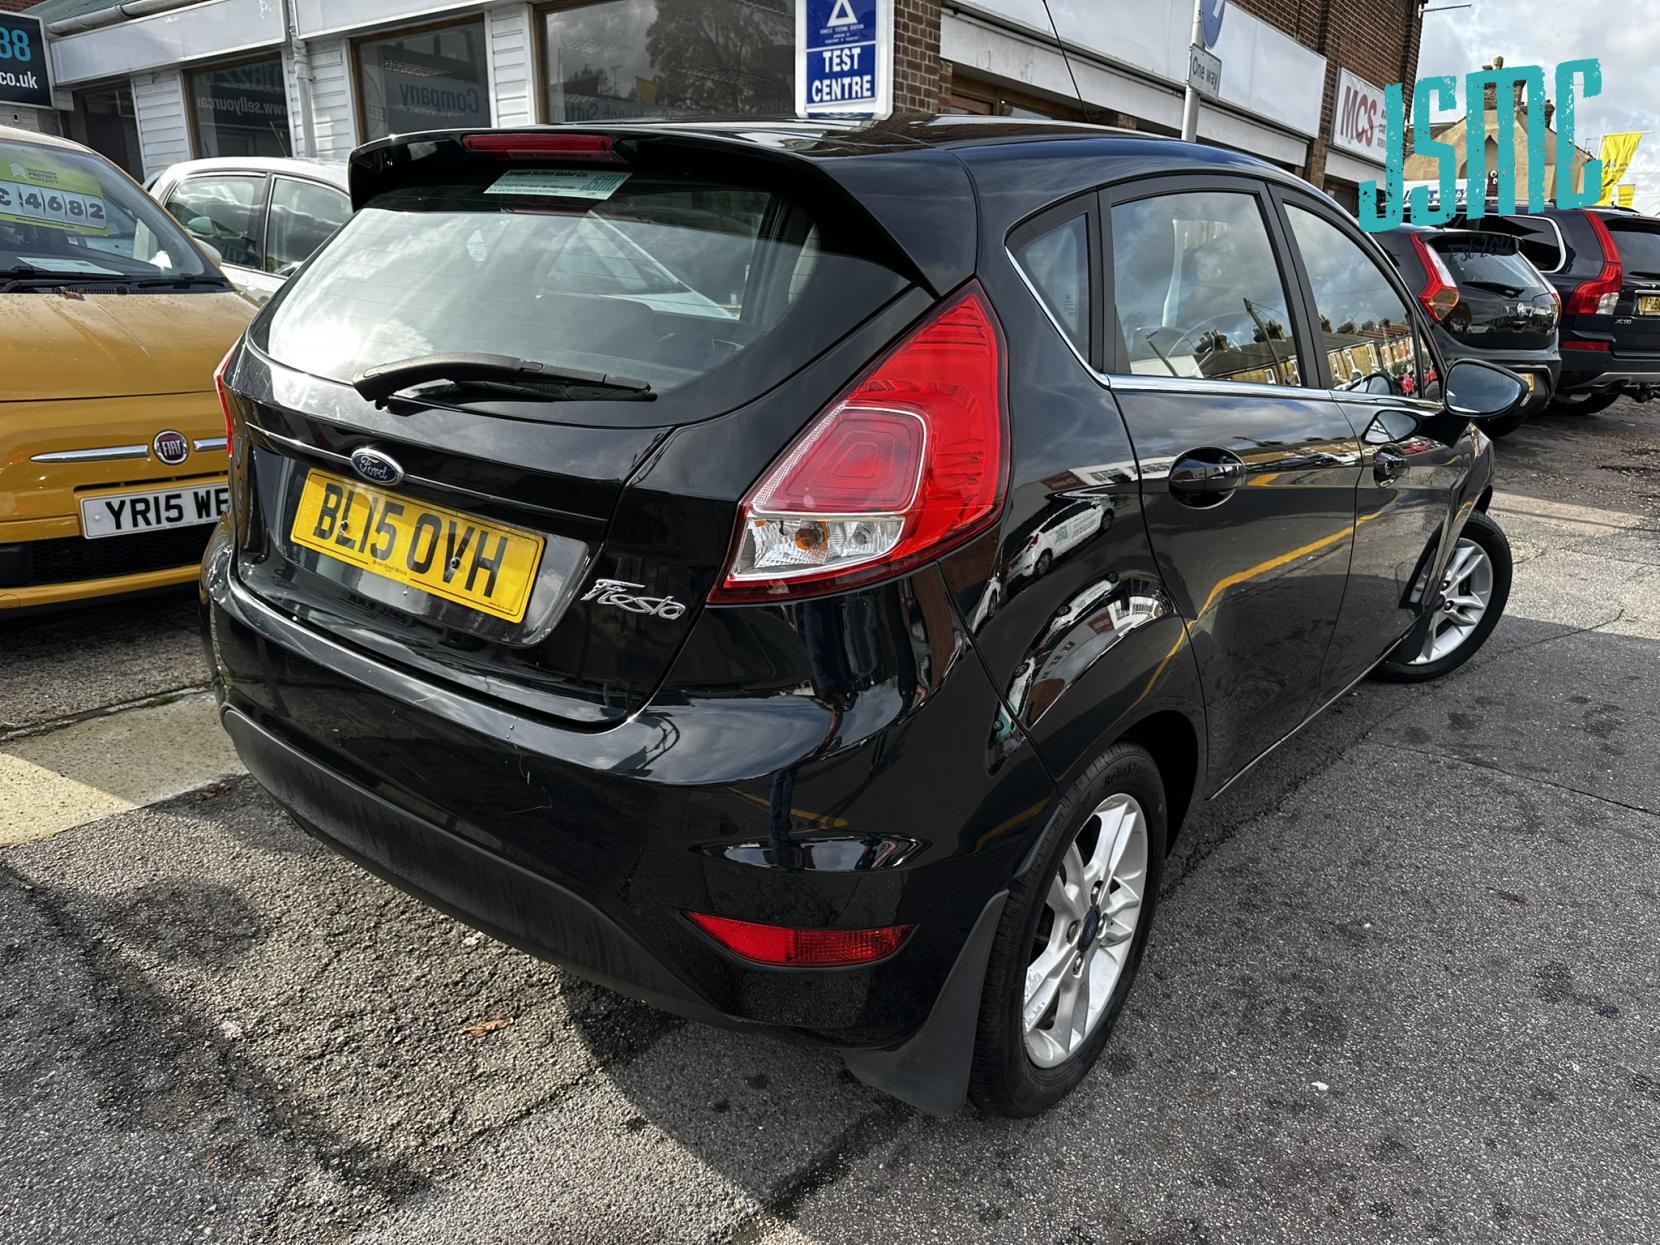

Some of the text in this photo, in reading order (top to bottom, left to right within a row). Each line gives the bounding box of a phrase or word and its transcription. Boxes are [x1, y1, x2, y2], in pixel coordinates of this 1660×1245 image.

[822, 47, 861, 73] TEST
[1193, 56, 1218, 91] One way
[811, 75, 872, 102] CENTRE
[1340, 85, 1377, 147] MCS
[161, 439, 182, 456] FIAT
[359, 455, 388, 480] Ford
[105, 487, 229, 530] YR15 WE
[313, 482, 508, 599] BL15 OVH
[580, 579, 686, 620] Fiesta
